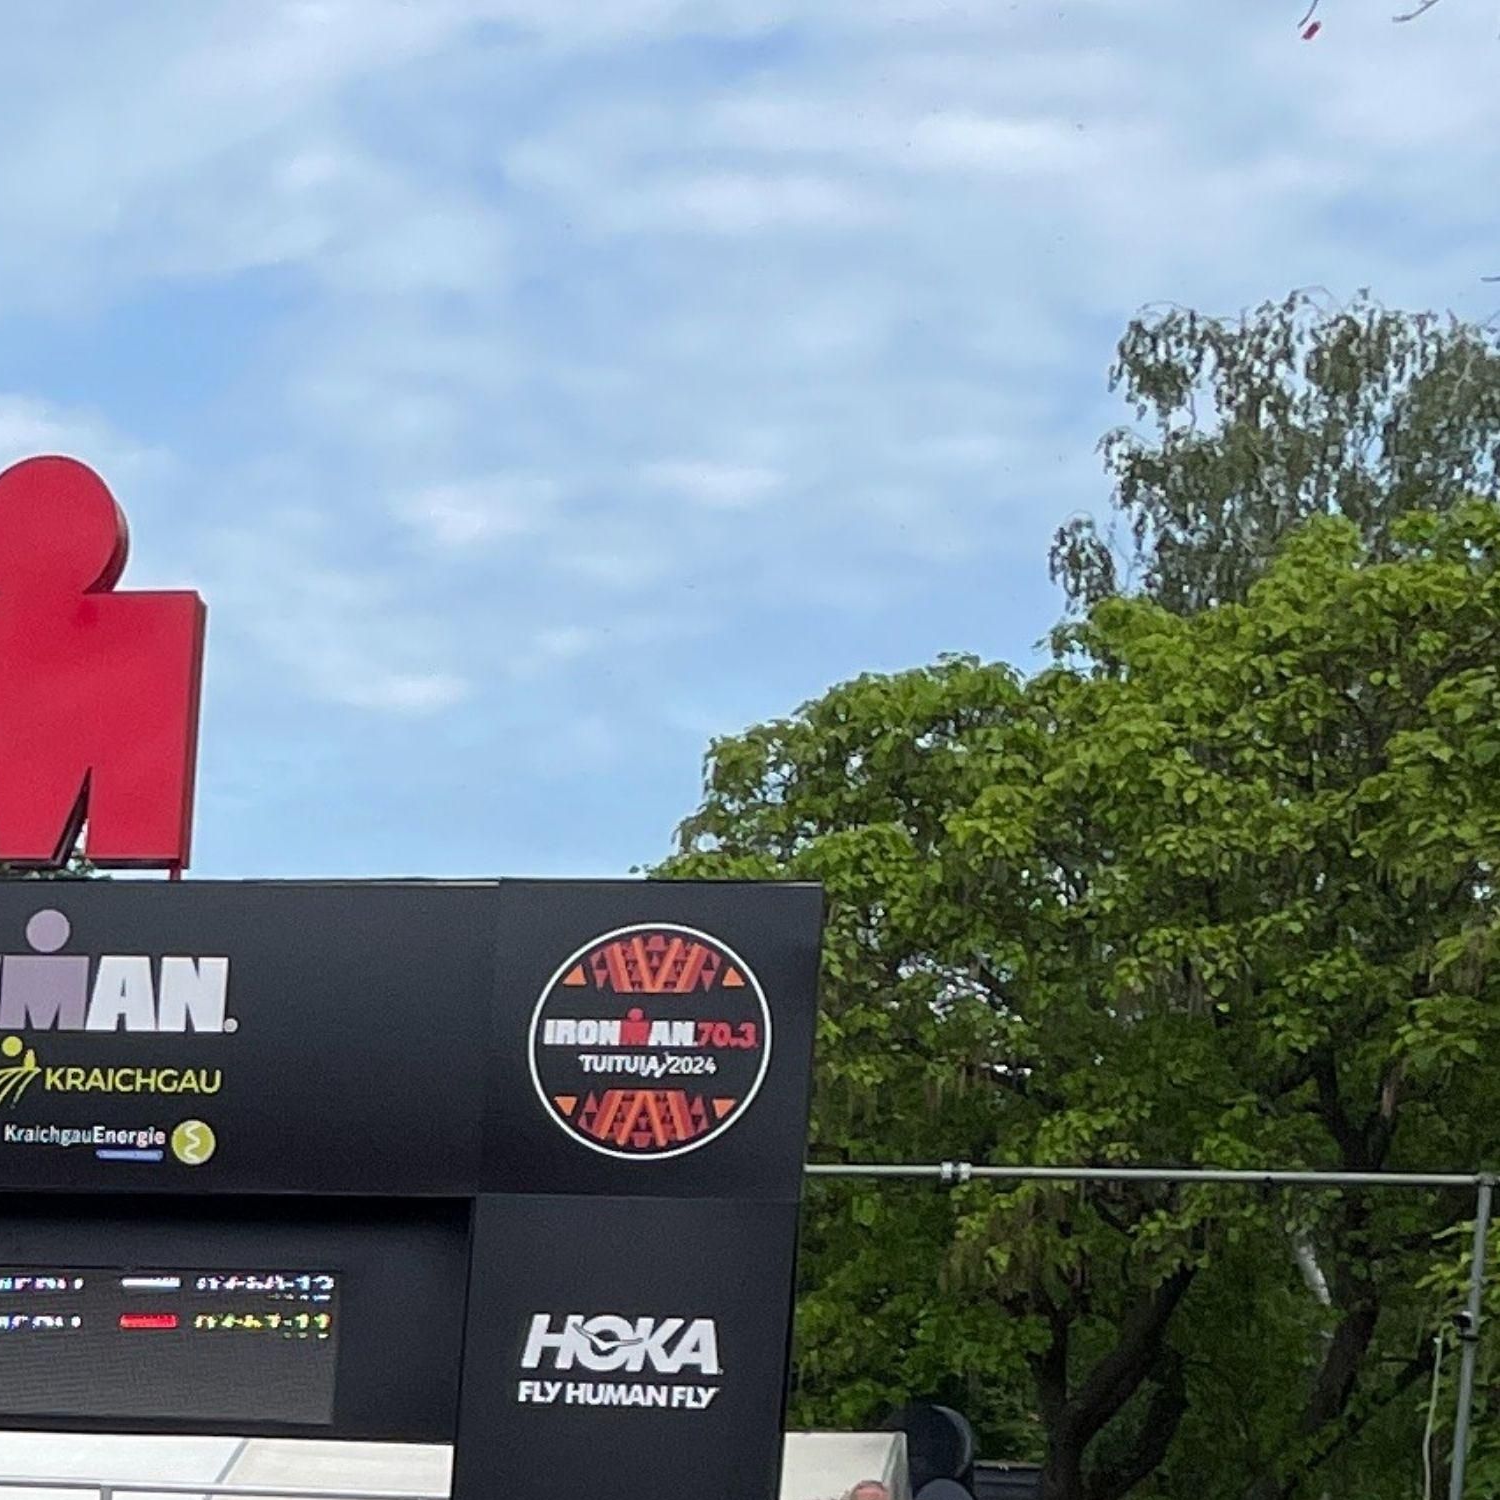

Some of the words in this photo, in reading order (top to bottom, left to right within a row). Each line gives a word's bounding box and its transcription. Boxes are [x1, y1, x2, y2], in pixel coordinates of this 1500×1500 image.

[543, 1008, 696, 1046] IRONMAN
[697, 1022, 757, 1047] 70.3
[44, 1067, 221, 1093] KRAICHGAU
[4, 1124, 166, 1148] KraichgauEnergie
[521, 1314, 719, 1374] HOKA
[518, 1380, 563, 1402] FLY
[565, 1382, 669, 1408] HUMAN
[671, 1386, 719, 1409] FLY
